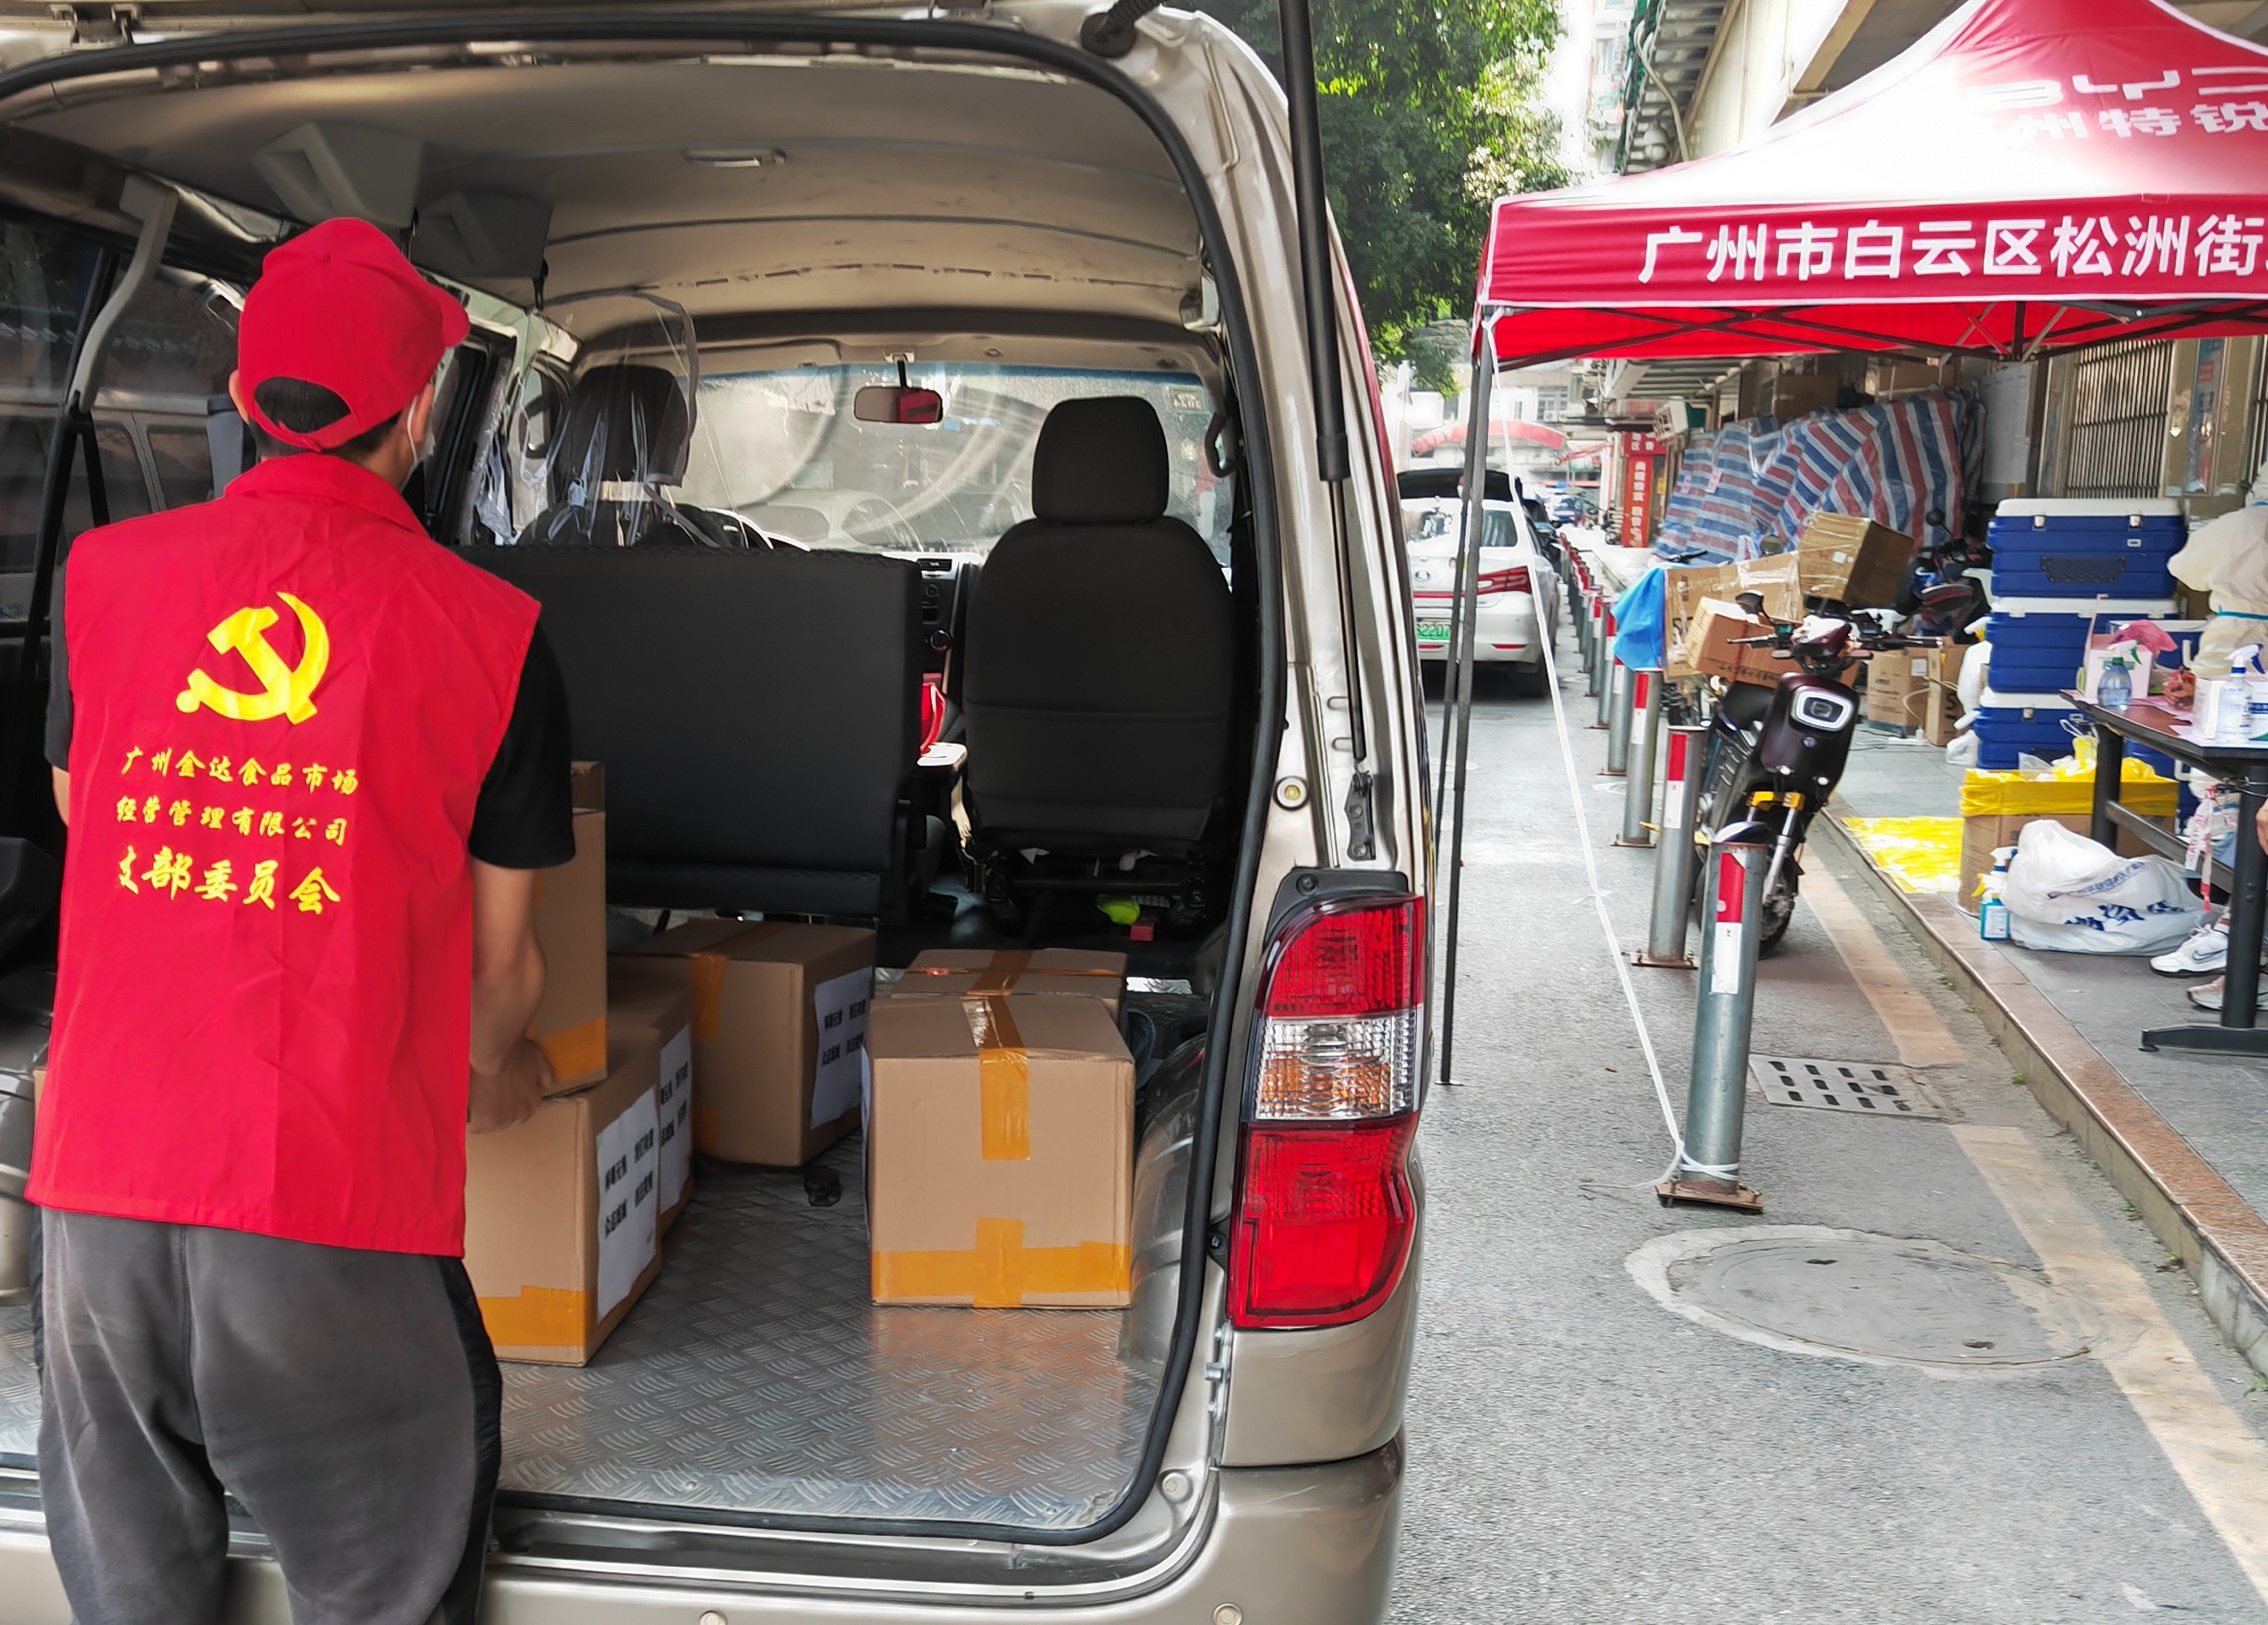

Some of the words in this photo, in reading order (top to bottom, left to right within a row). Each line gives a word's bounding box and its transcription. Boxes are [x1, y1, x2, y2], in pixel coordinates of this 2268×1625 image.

[1637, 214, 2265, 284] 广州市白云区松洲街
[121, 746, 358, 795] 广州金达食品市场
[116, 795, 347, 846] 经营管理有限公司
